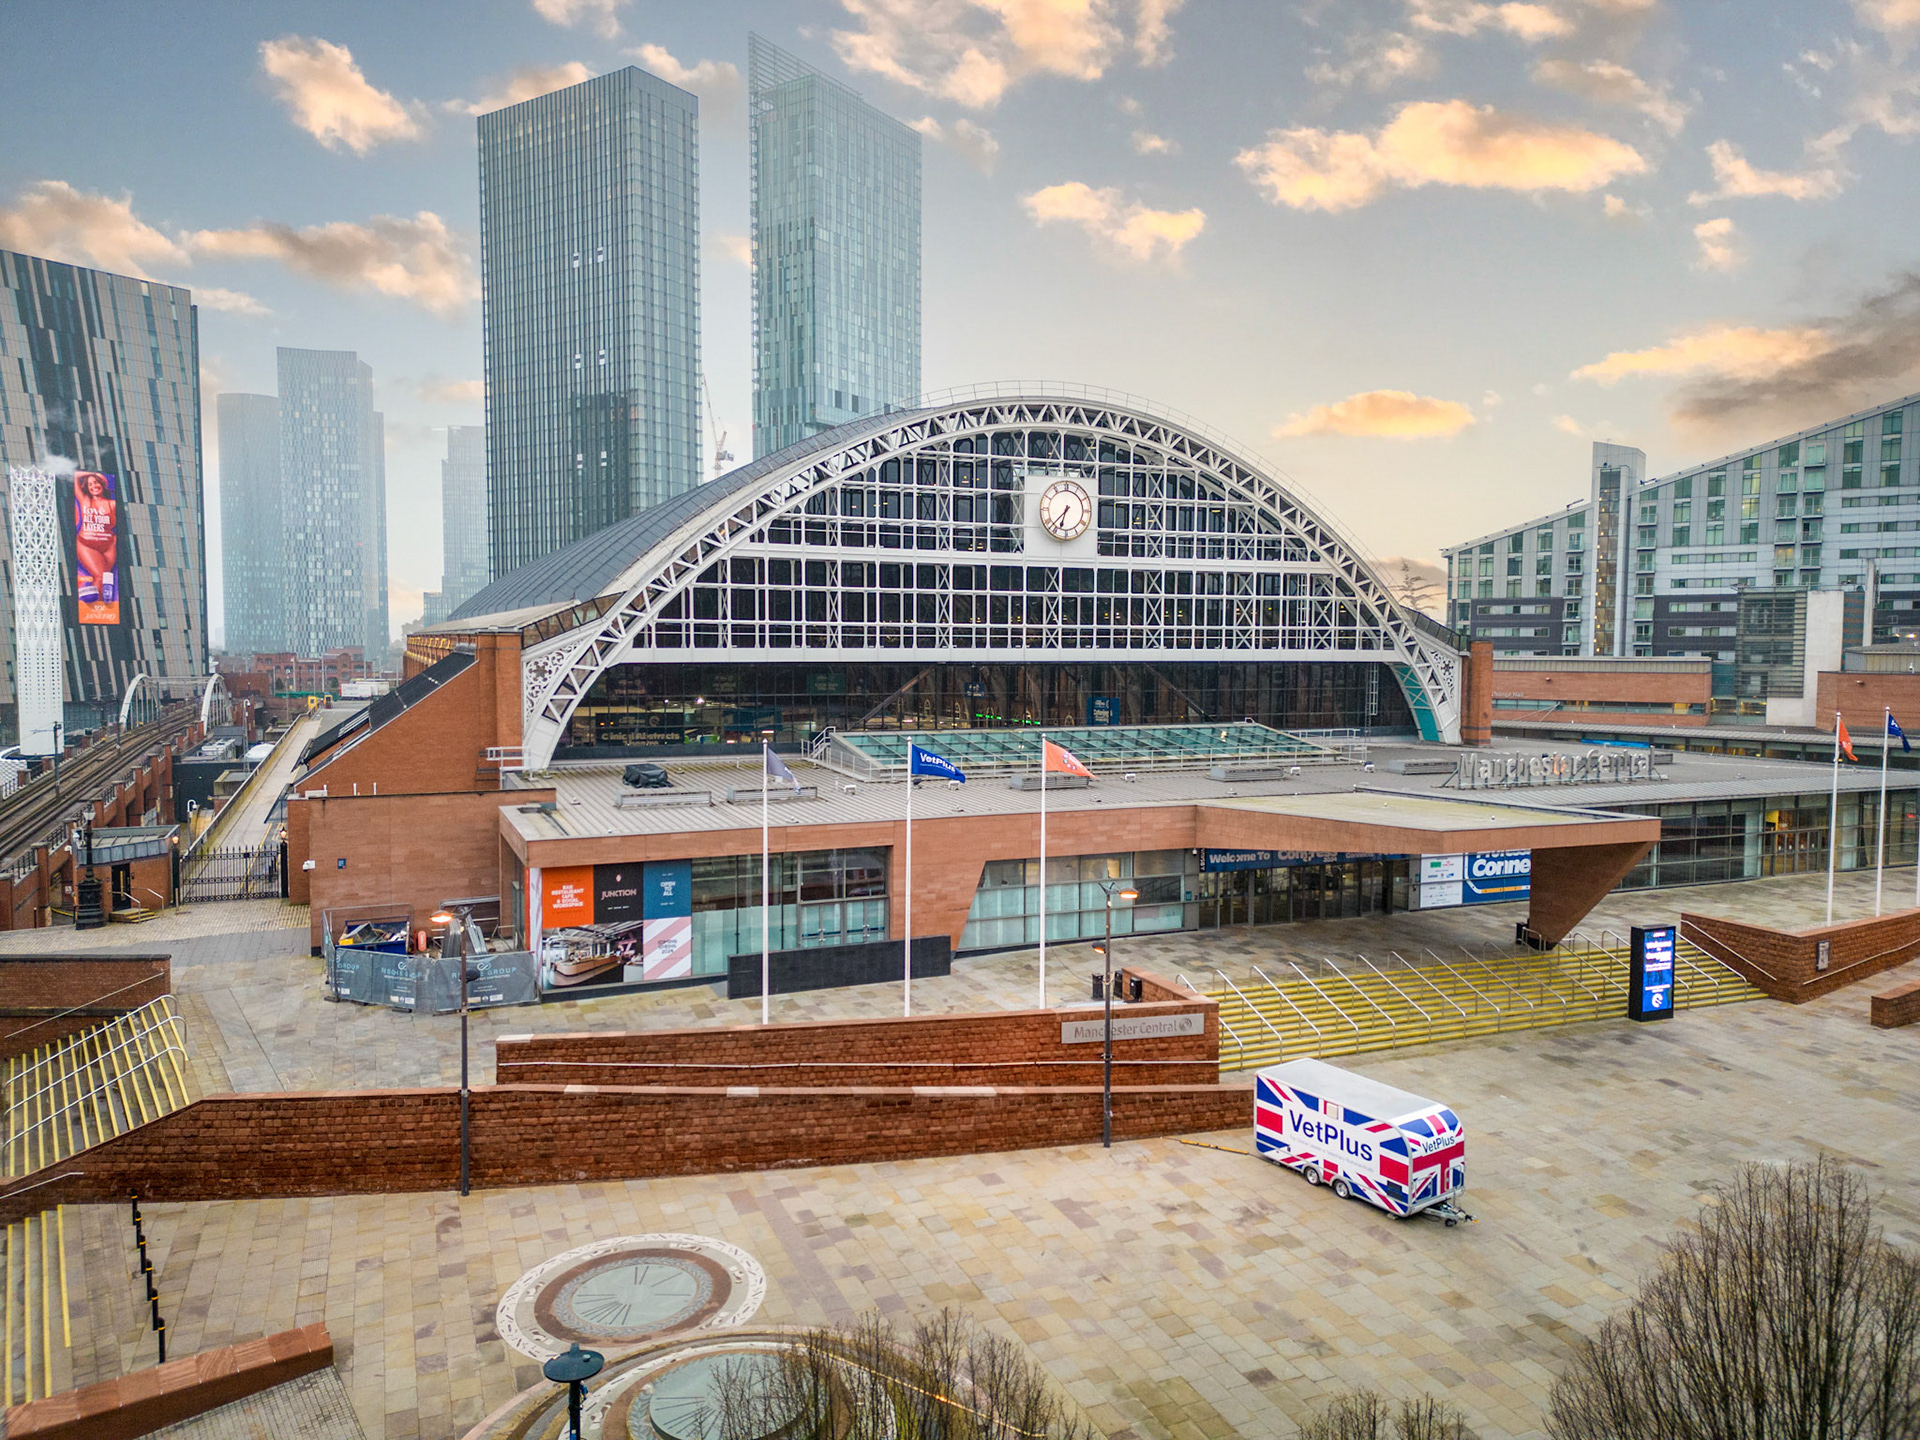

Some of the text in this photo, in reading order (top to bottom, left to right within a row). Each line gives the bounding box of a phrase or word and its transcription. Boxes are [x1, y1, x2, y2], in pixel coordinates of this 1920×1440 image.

[919, 752, 956, 773] VetPlus
[1459, 745, 1655, 779] Manchester Central
[1257, 851, 1271, 861] To
[601, 889, 637, 900] JUNCTION
[1074, 1019, 1177, 1039] Mancester Central
[1289, 1109, 1373, 1162] VetPlus
[1421, 1134, 1455, 1154] VetPlus
